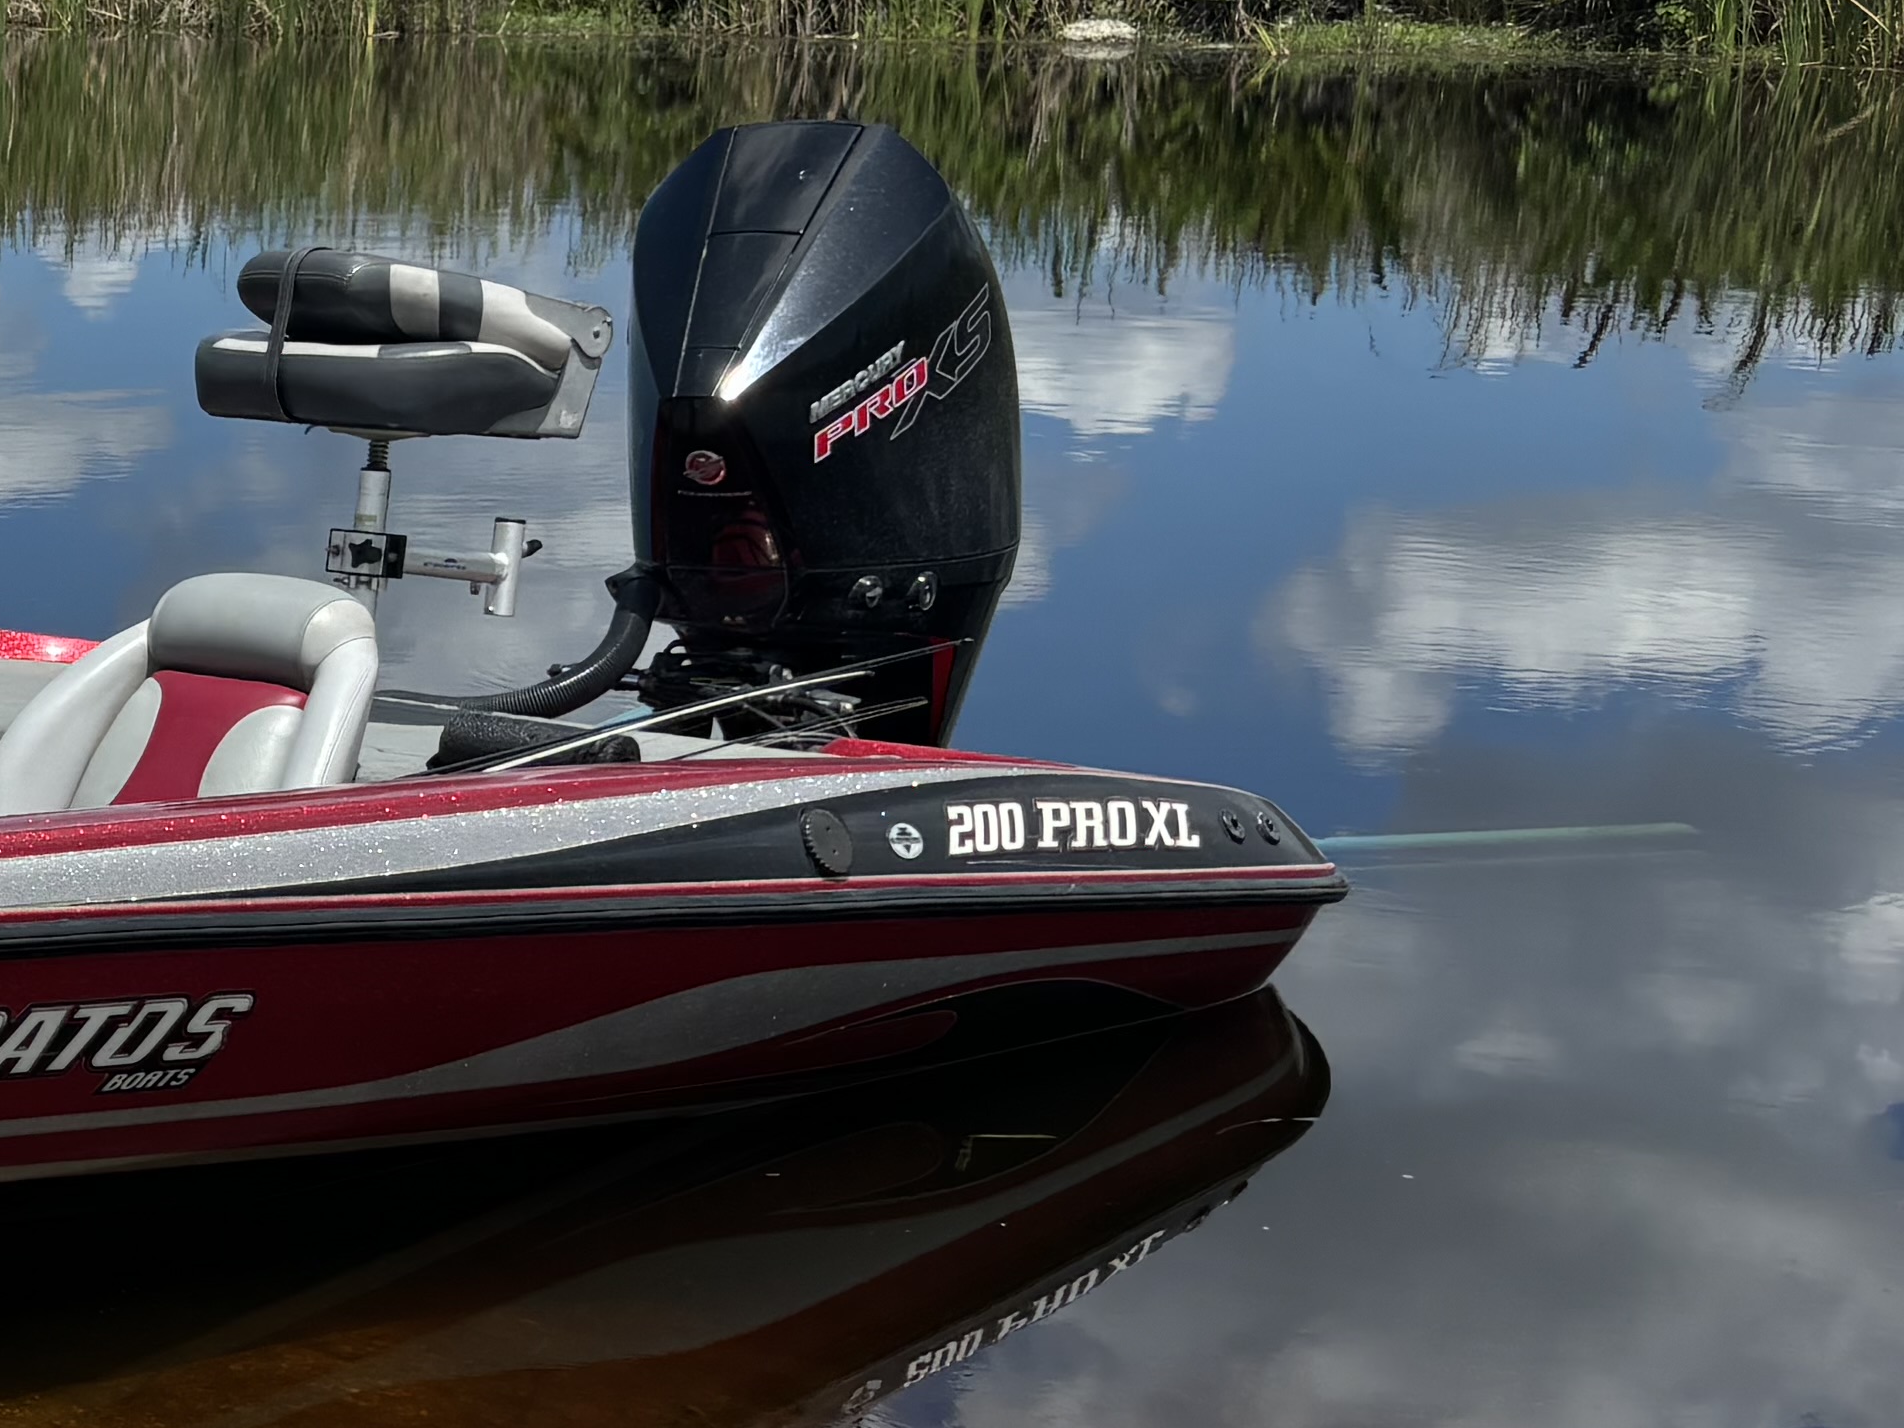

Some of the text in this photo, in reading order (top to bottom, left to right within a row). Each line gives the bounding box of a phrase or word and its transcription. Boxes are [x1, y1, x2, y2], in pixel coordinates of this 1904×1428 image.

[810, 340, 905, 423] MERCURY
[814, 356, 928, 463] PRO
[947, 799, 1201, 856] 200 PRO XL
[101, 1067, 196, 1092] BOATS
